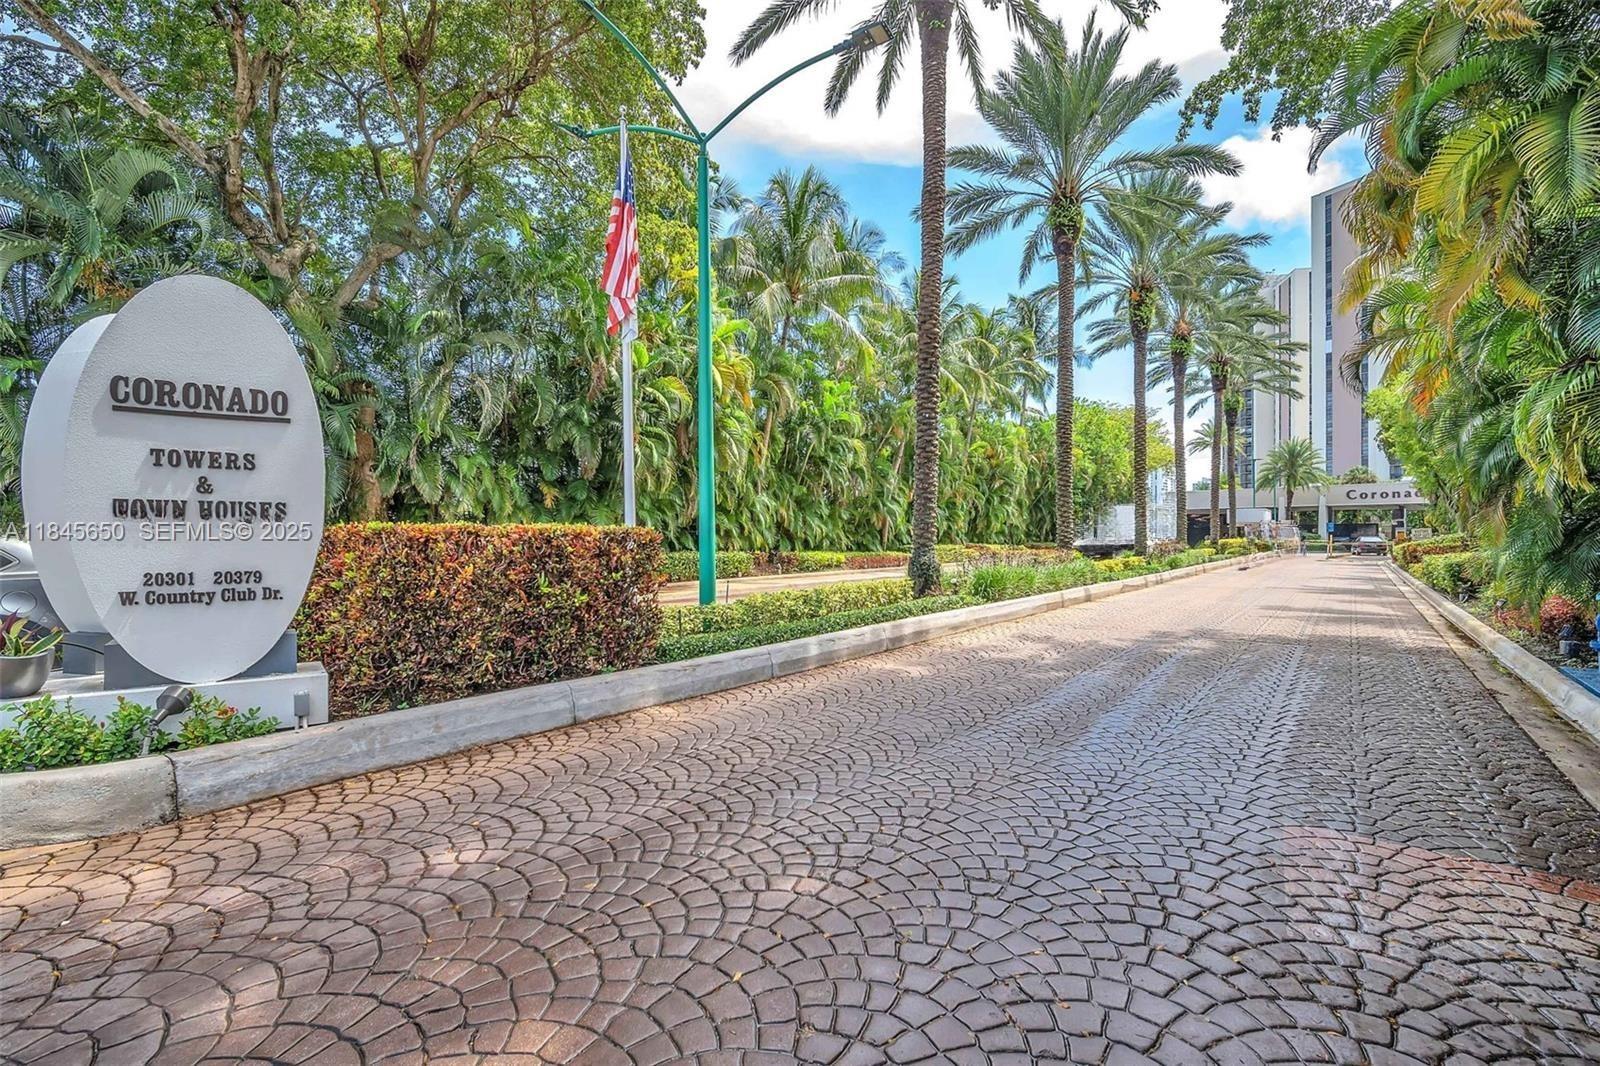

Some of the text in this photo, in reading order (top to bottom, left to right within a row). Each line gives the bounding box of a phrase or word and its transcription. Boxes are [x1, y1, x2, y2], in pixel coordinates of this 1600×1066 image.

[109, 375, 289, 416] CORONADO
[149, 448, 256, 471] TOWERS
[195, 476, 214, 494] &
[197, 500, 287, 523] HOUSES
[143, 570, 263, 587] 20301 20379
[118, 586, 284, 606] W. Country Club Dr.
